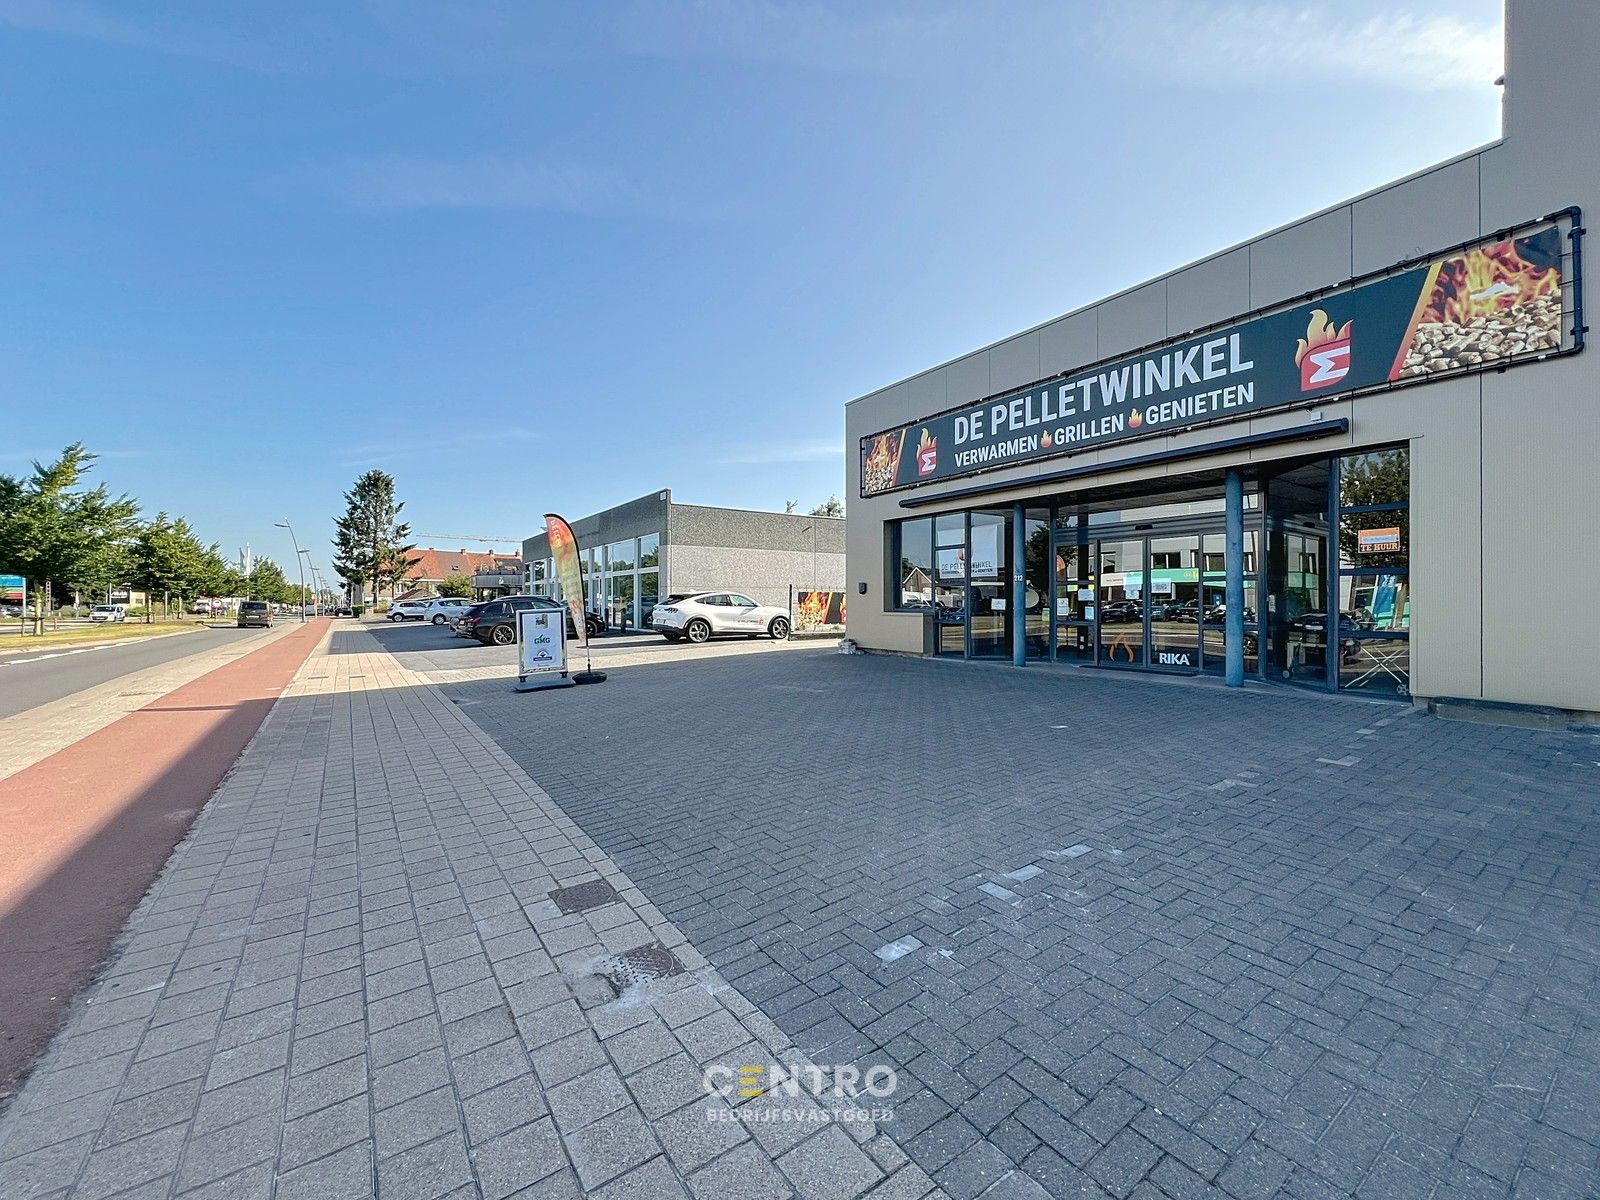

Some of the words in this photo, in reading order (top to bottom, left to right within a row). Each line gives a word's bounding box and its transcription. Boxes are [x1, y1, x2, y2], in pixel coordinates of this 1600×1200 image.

[954, 410, 984, 445] DE
[991, 333, 1254, 436] PELLETWINKEL
[954, 434, 1038, 468] VERWARMEN
[1054, 414, 1124, 445] GRILLEN
[1145, 381, 1254, 425] GENIETEN
[1374, 543, 1397, 551] HUUR
[1159, 652, 1190, 665] RIKA
